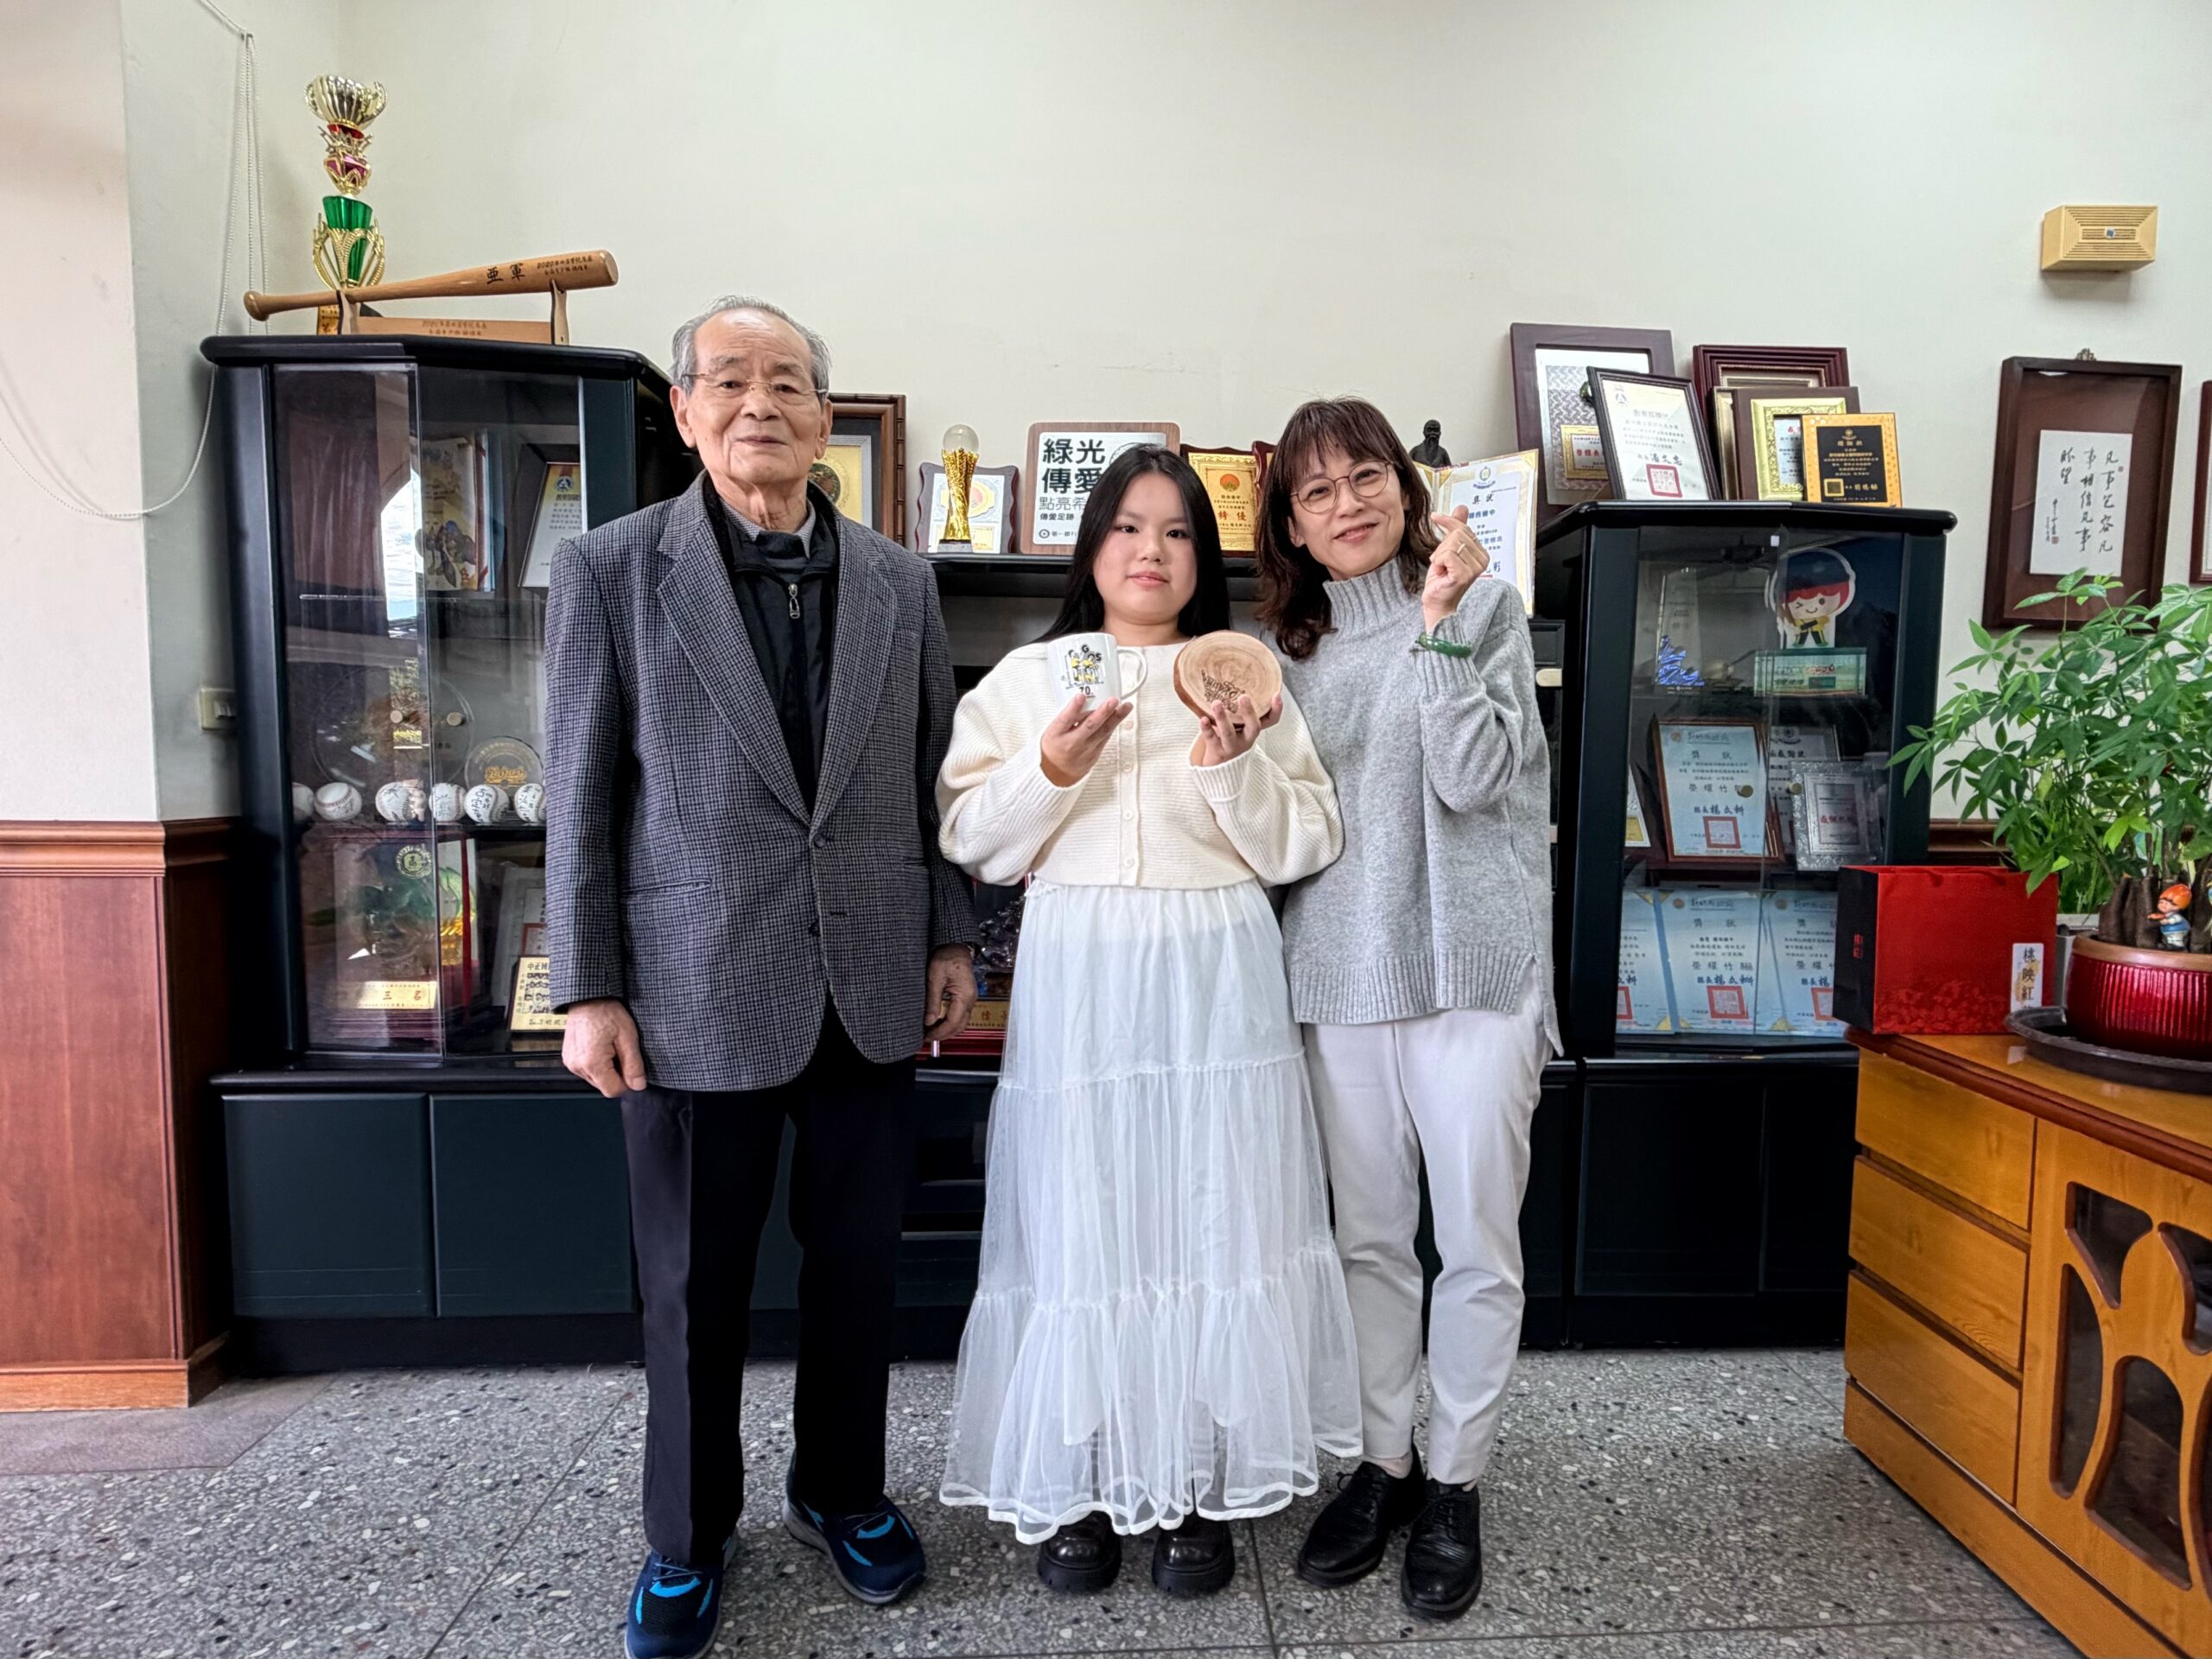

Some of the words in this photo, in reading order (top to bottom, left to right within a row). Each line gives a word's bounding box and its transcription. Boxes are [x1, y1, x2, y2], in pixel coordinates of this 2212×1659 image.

[1042, 438, 1105, 464] 綠光
[1041, 467, 1103, 493] 傳愛
[2022, 947, 2036, 1009] 桃映紅
